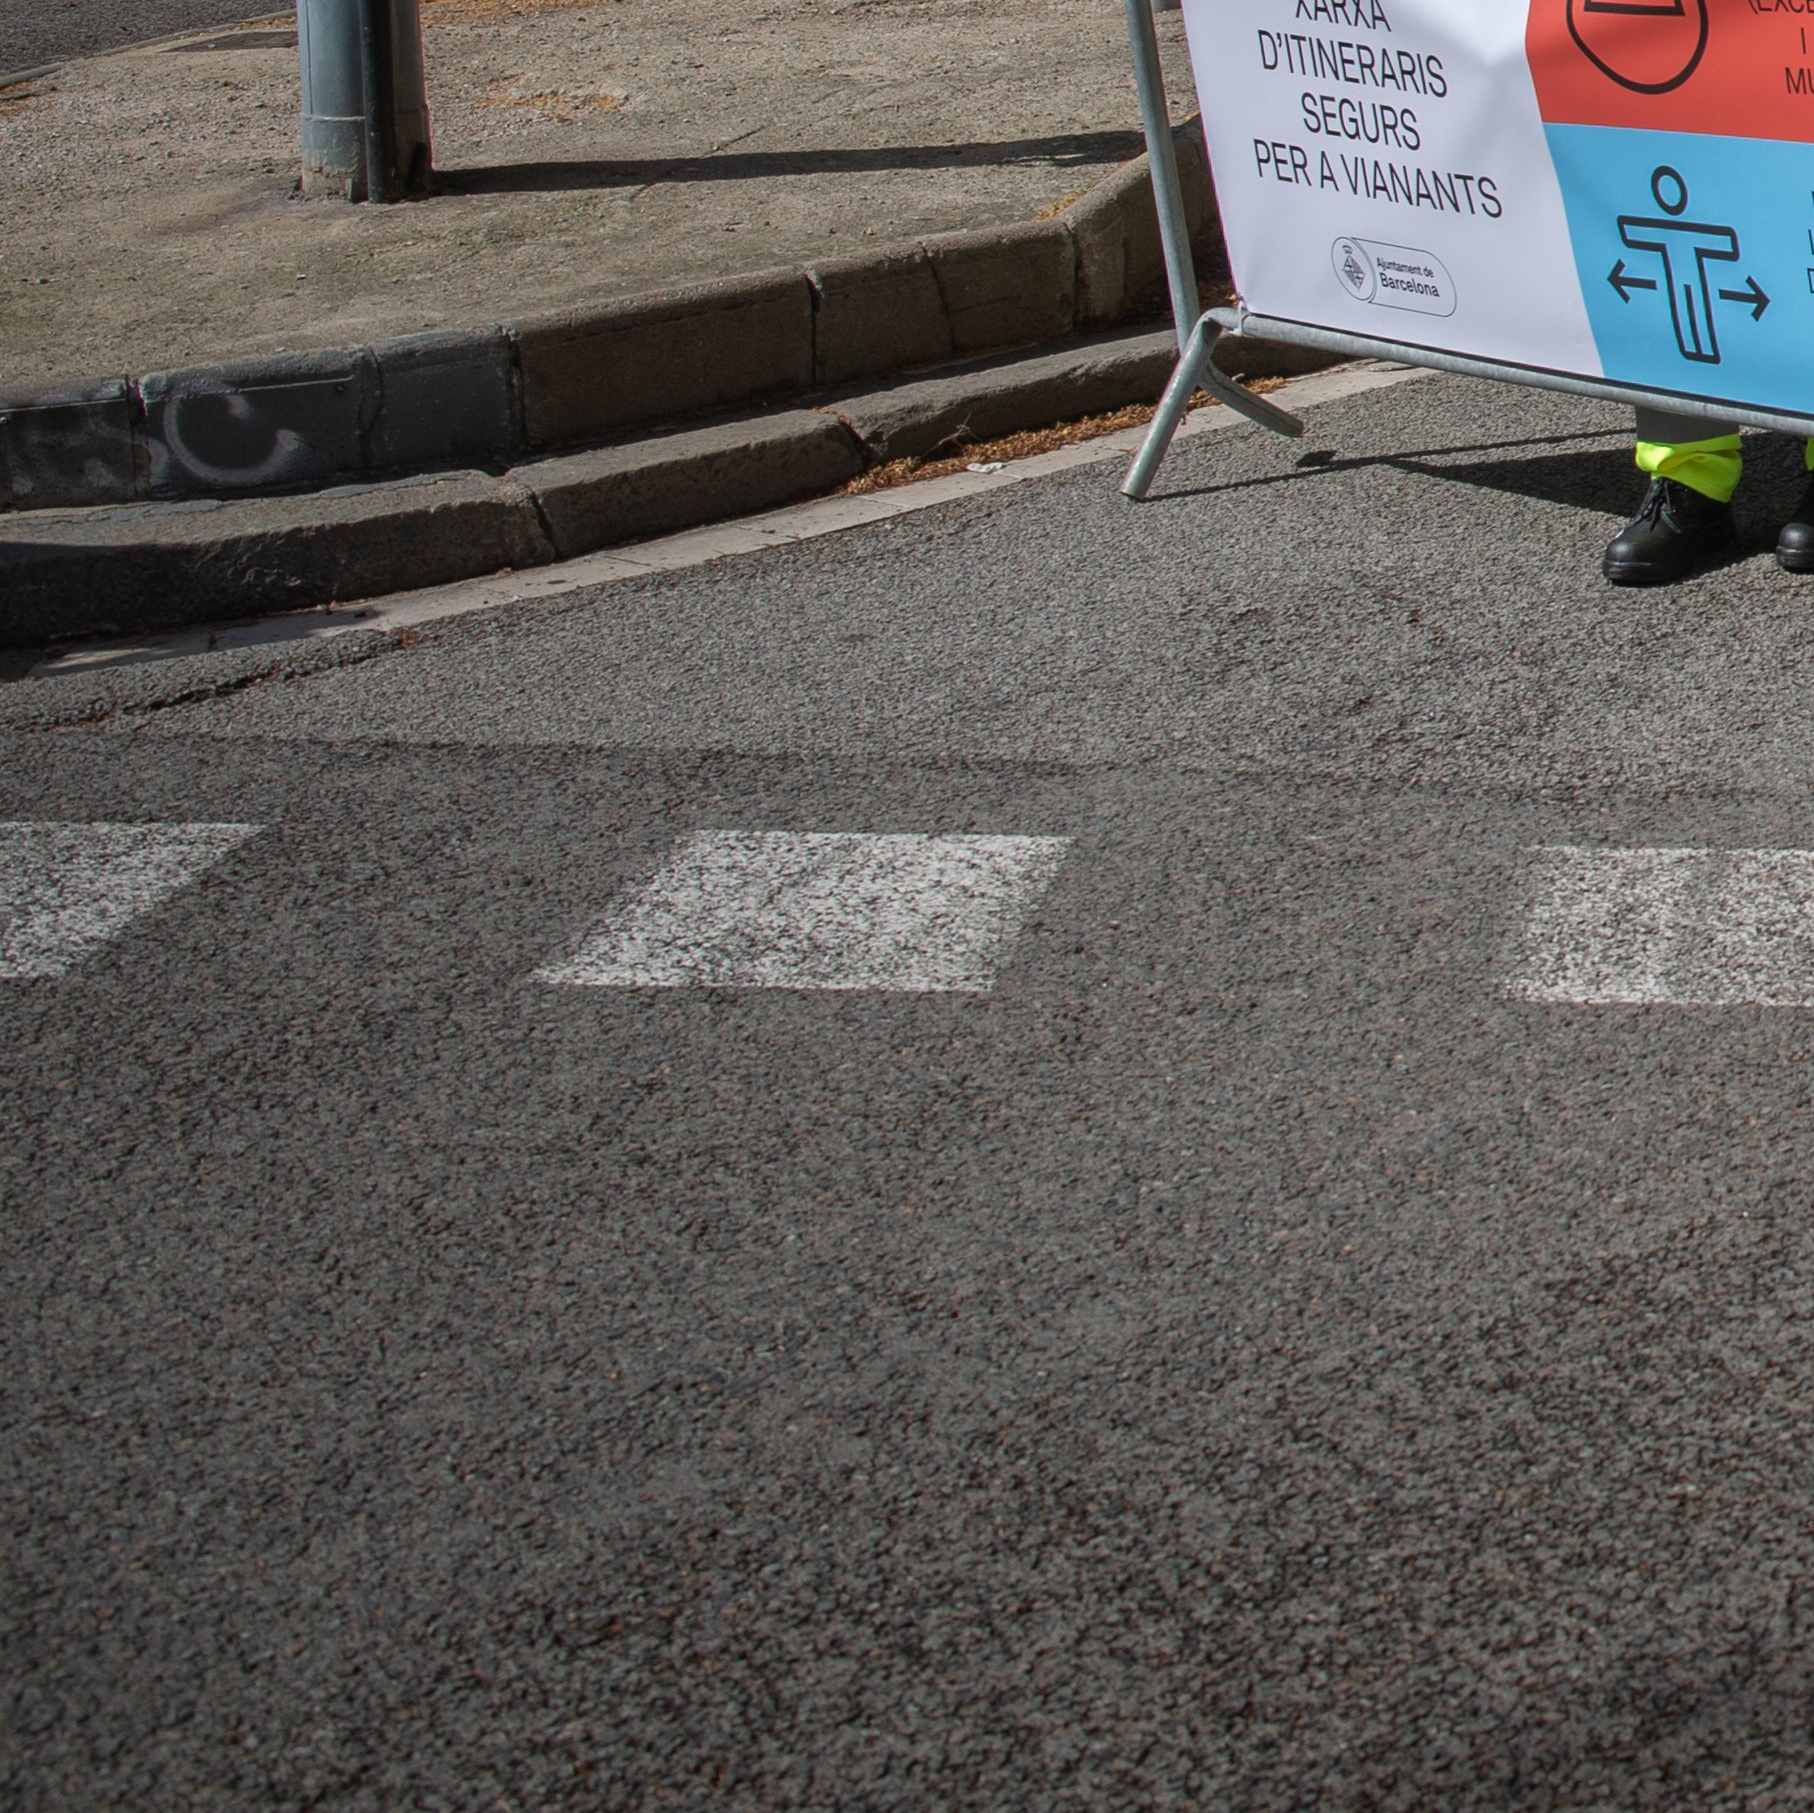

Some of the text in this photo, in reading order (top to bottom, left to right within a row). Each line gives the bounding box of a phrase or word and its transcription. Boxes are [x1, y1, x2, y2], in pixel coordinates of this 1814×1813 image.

[1800, 27, 1807, 54] I
[1257, 29, 1448, 98] D'ITINERARIS
[1301, 92, 1420, 151] SEGURS
[1253, 138, 1503, 219] PER A VIANANTS
[1376, 257, 1435, 278] Ajuntament de
[1379, 272, 1440, 297] Barcelona
